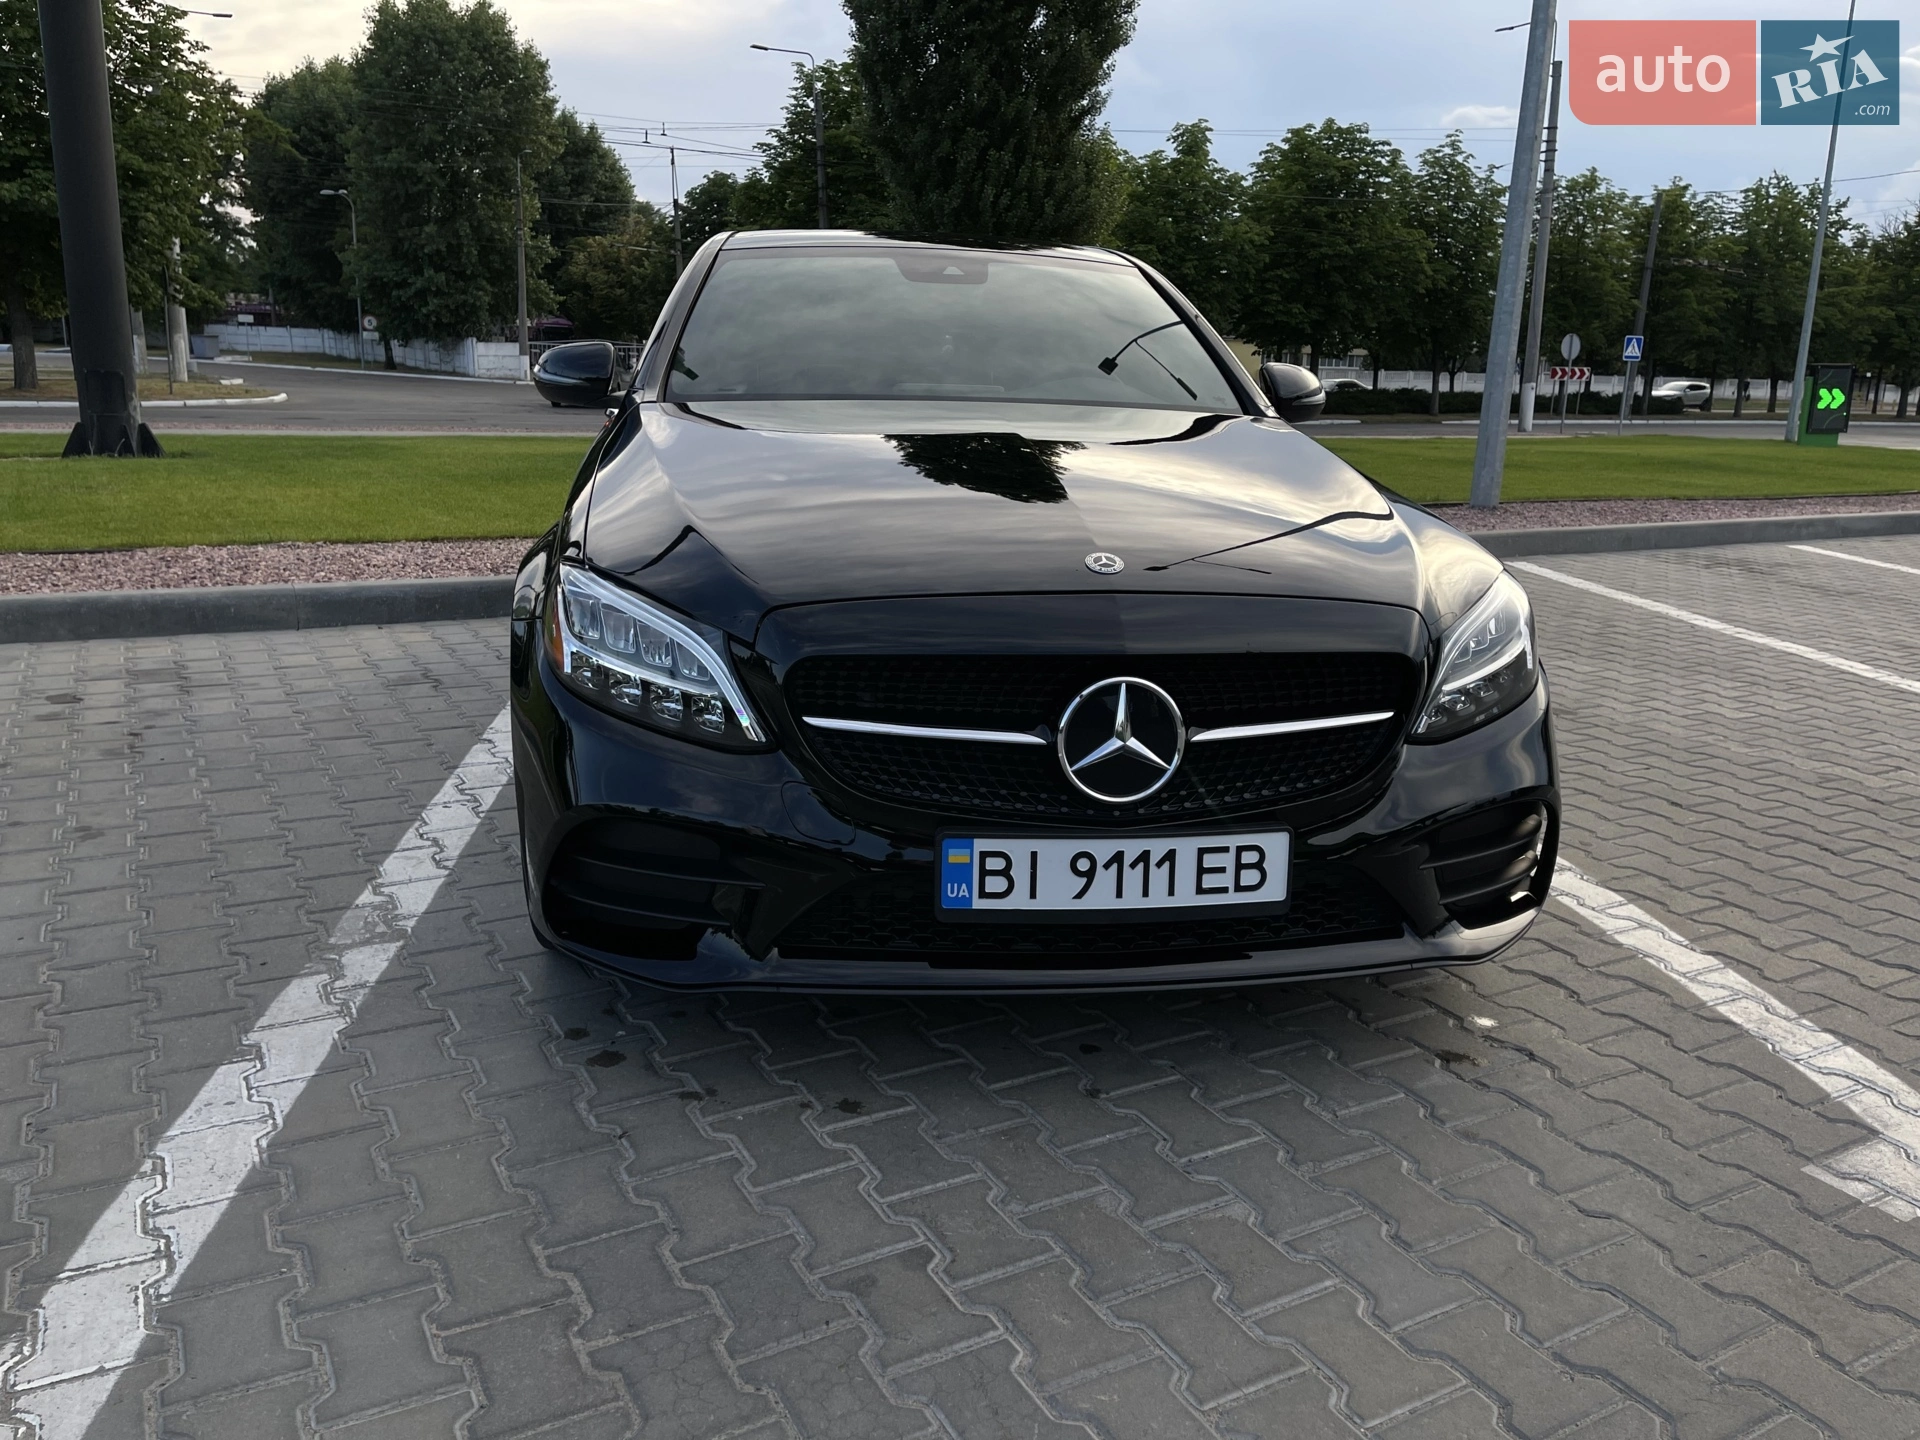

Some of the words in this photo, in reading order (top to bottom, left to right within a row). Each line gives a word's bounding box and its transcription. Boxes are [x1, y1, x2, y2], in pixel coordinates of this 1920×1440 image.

[977, 850, 1038, 900] BI
[1069, 848, 1177, 900] 9111
[1195, 843, 1268, 895] EB
[947, 883, 970, 898] UA
